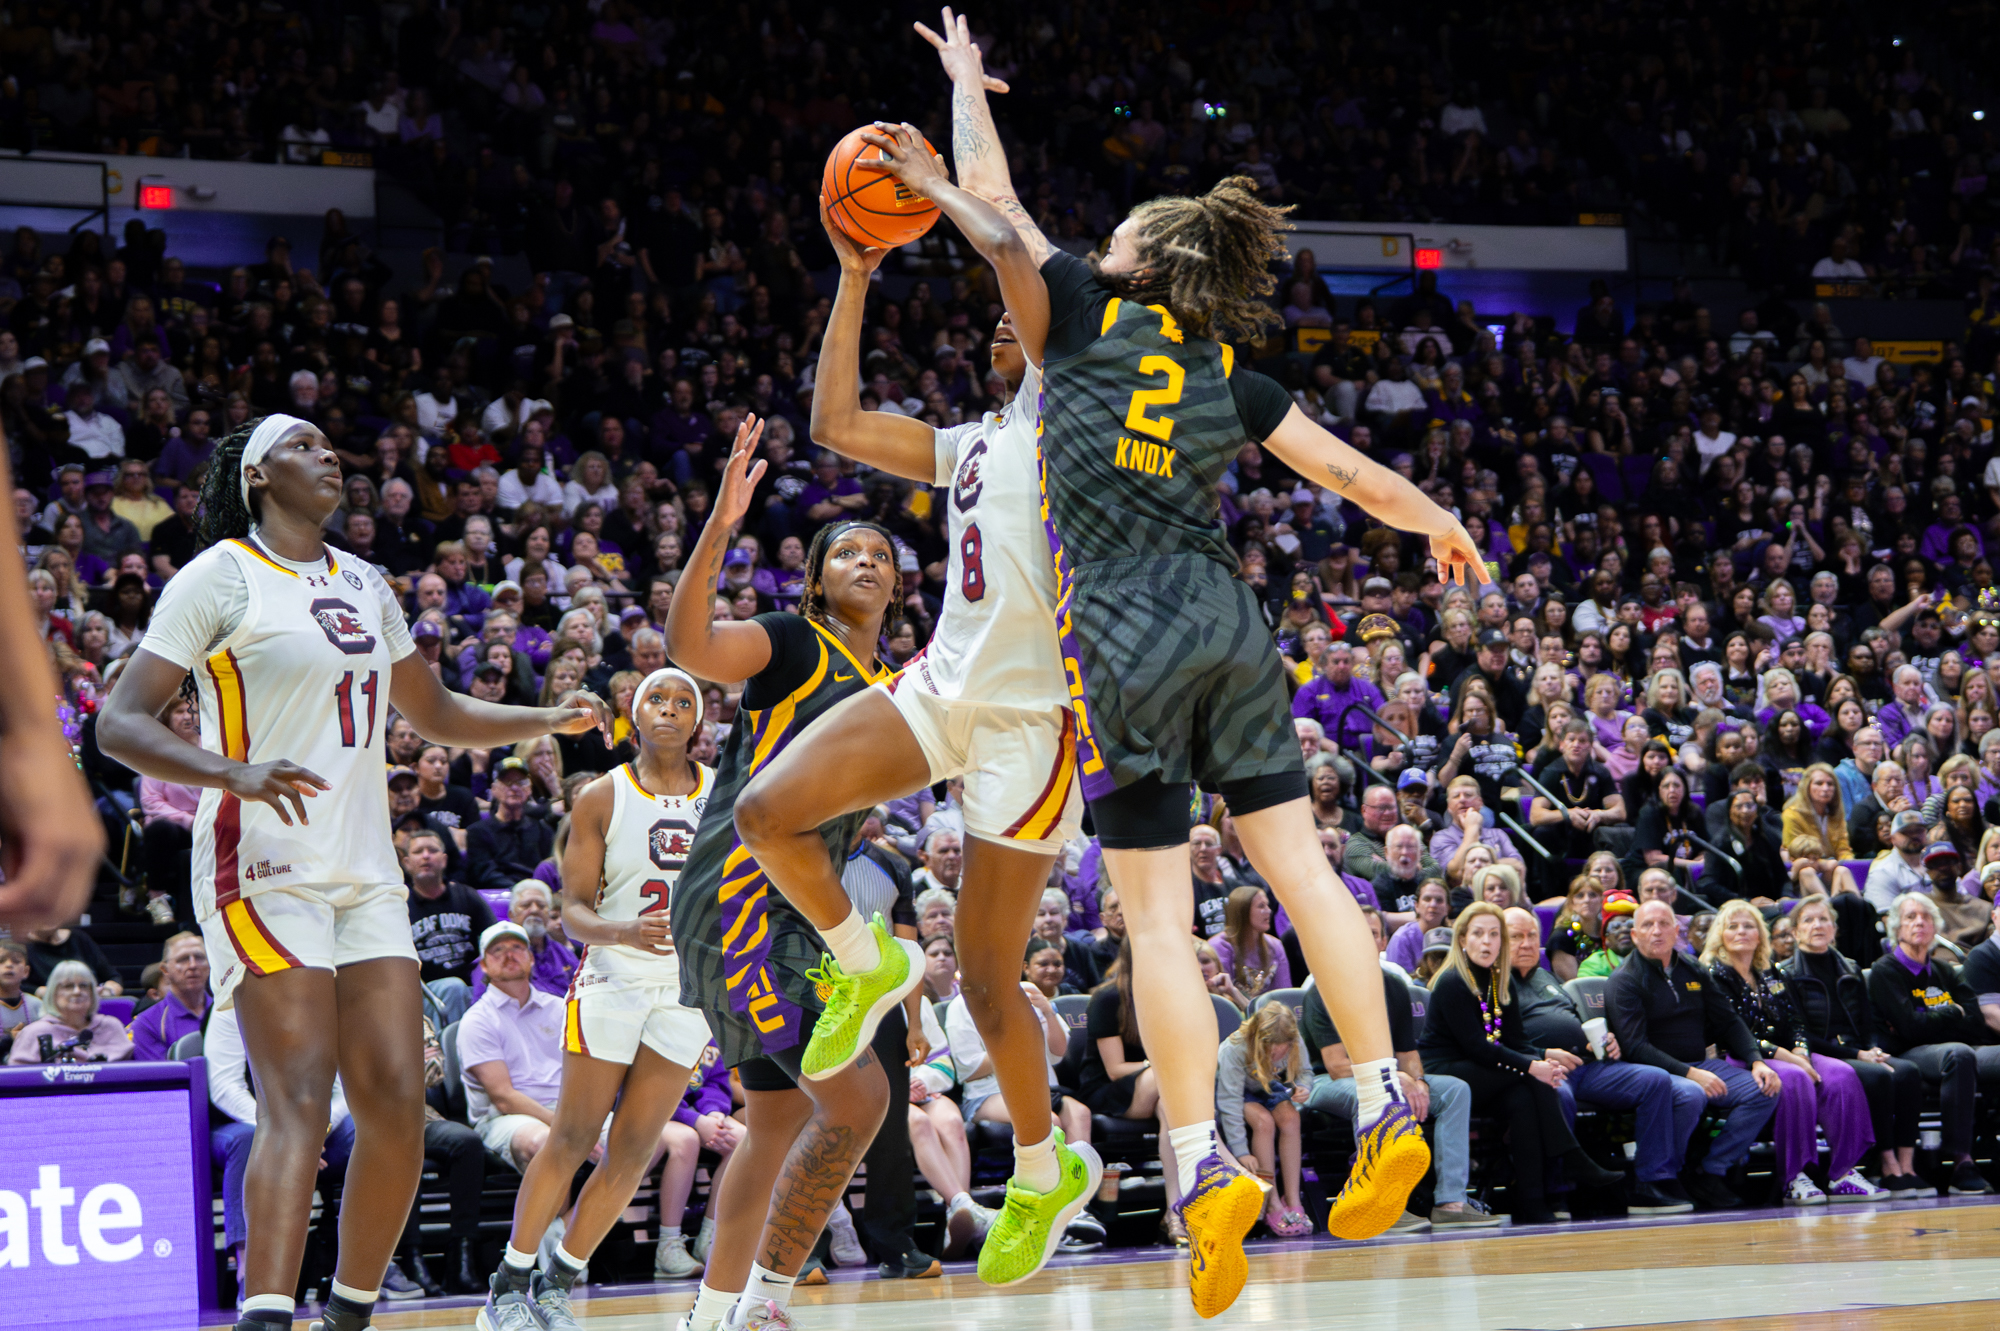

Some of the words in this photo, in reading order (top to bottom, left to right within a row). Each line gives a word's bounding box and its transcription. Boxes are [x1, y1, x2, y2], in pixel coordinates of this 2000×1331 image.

[1125, 355, 1186, 441] 2
[1115, 436, 1176, 479] KNOX
[961, 521, 986, 603] 8
[334, 670, 378, 749] 11
[245, 863, 256, 881] 4
[256, 859, 271, 870] THE
[257, 864, 292, 879] CULTURE
[638, 879, 677, 917] 2
[439, 912, 472, 933] DOME
[64, 1072, 95, 1083] Energy
